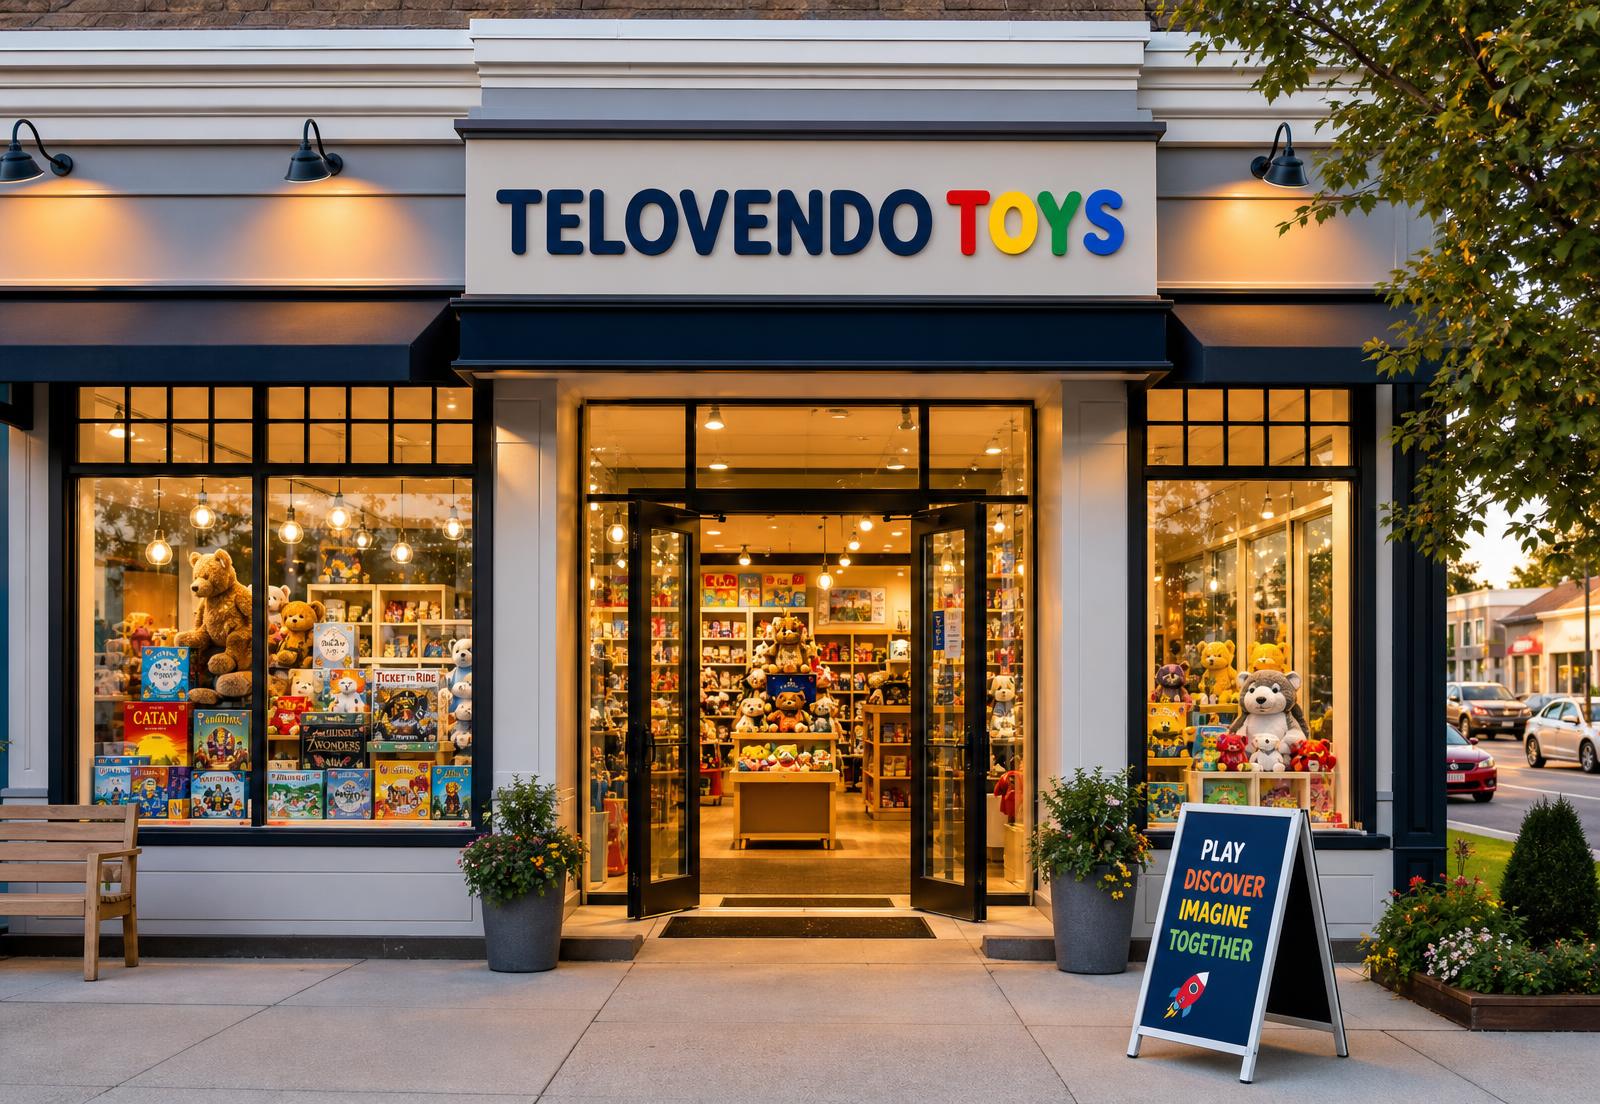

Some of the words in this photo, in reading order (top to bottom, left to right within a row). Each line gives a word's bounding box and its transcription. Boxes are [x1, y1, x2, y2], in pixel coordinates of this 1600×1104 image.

[496, 188, 933, 256] TELOVENDO
[946, 188, 1125, 256] TOYS
[376, 672, 405, 682] TICKET
[416, 673, 436, 682] RIDE
[133, 710, 178, 725] CATAN
[313, 740, 361, 751] WONDERS
[1201, 839, 1246, 864] PLAY
[1184, 868, 1266, 898] DISCOVER
[1178, 898, 1252, 929] IMAGINE
[1169, 928, 1254, 962] TOGETHER
